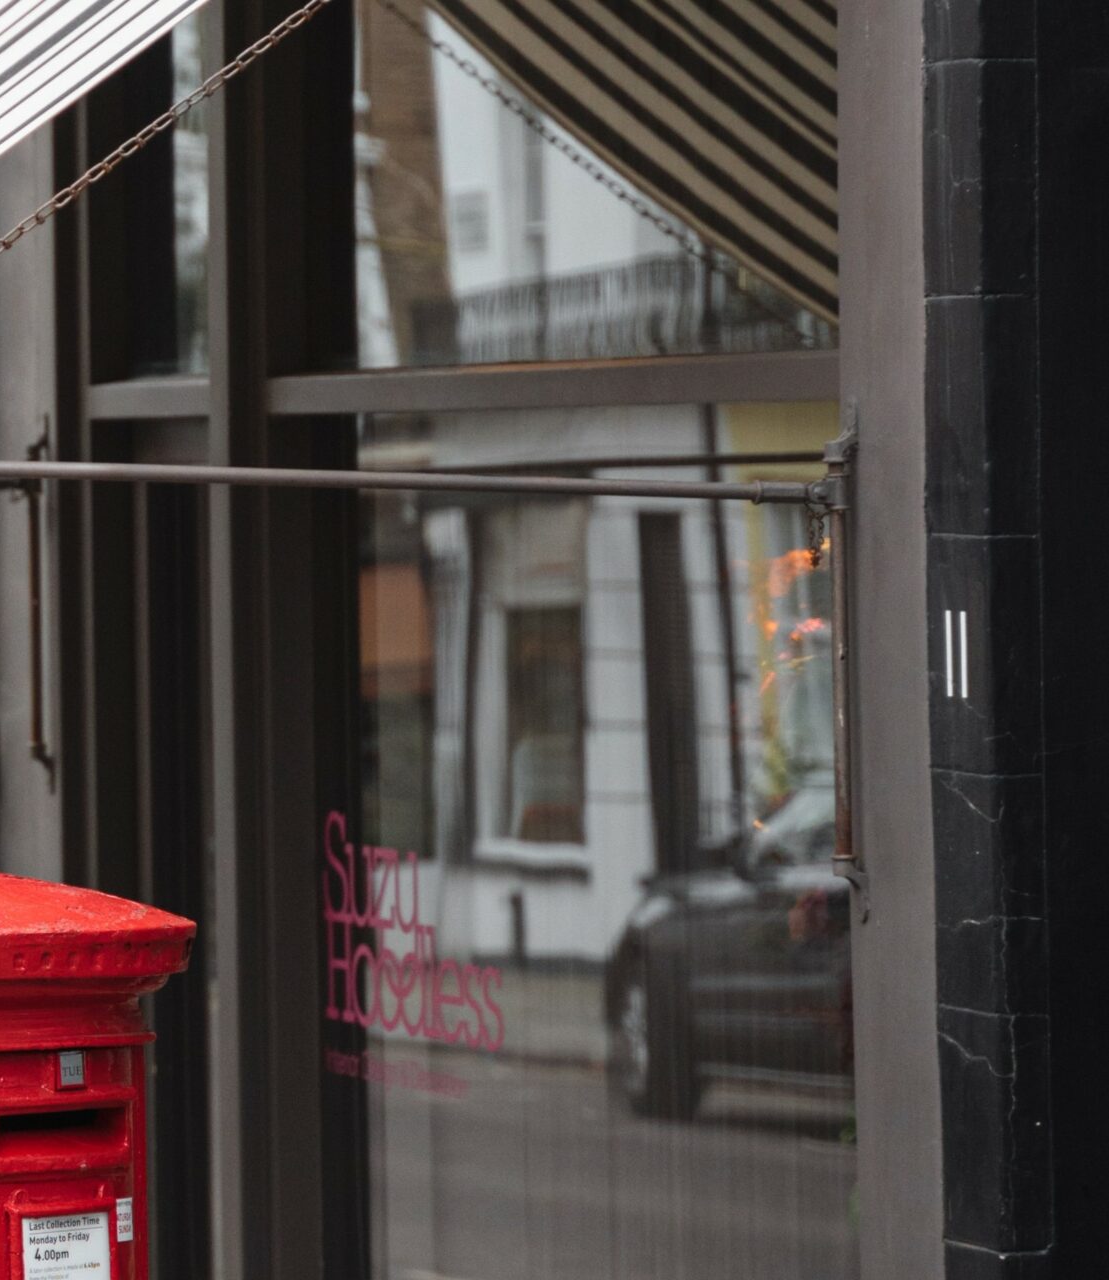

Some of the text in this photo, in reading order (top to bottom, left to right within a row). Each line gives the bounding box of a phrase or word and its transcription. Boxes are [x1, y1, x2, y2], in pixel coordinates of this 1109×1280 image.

[62, 1065, 82, 1077] TUE
[29, 1216, 100, 1231] Last Collection Time
[29, 1232, 90, 1246] Monday to Friday
[34, 1247, 70, 1262] 4.00pm
